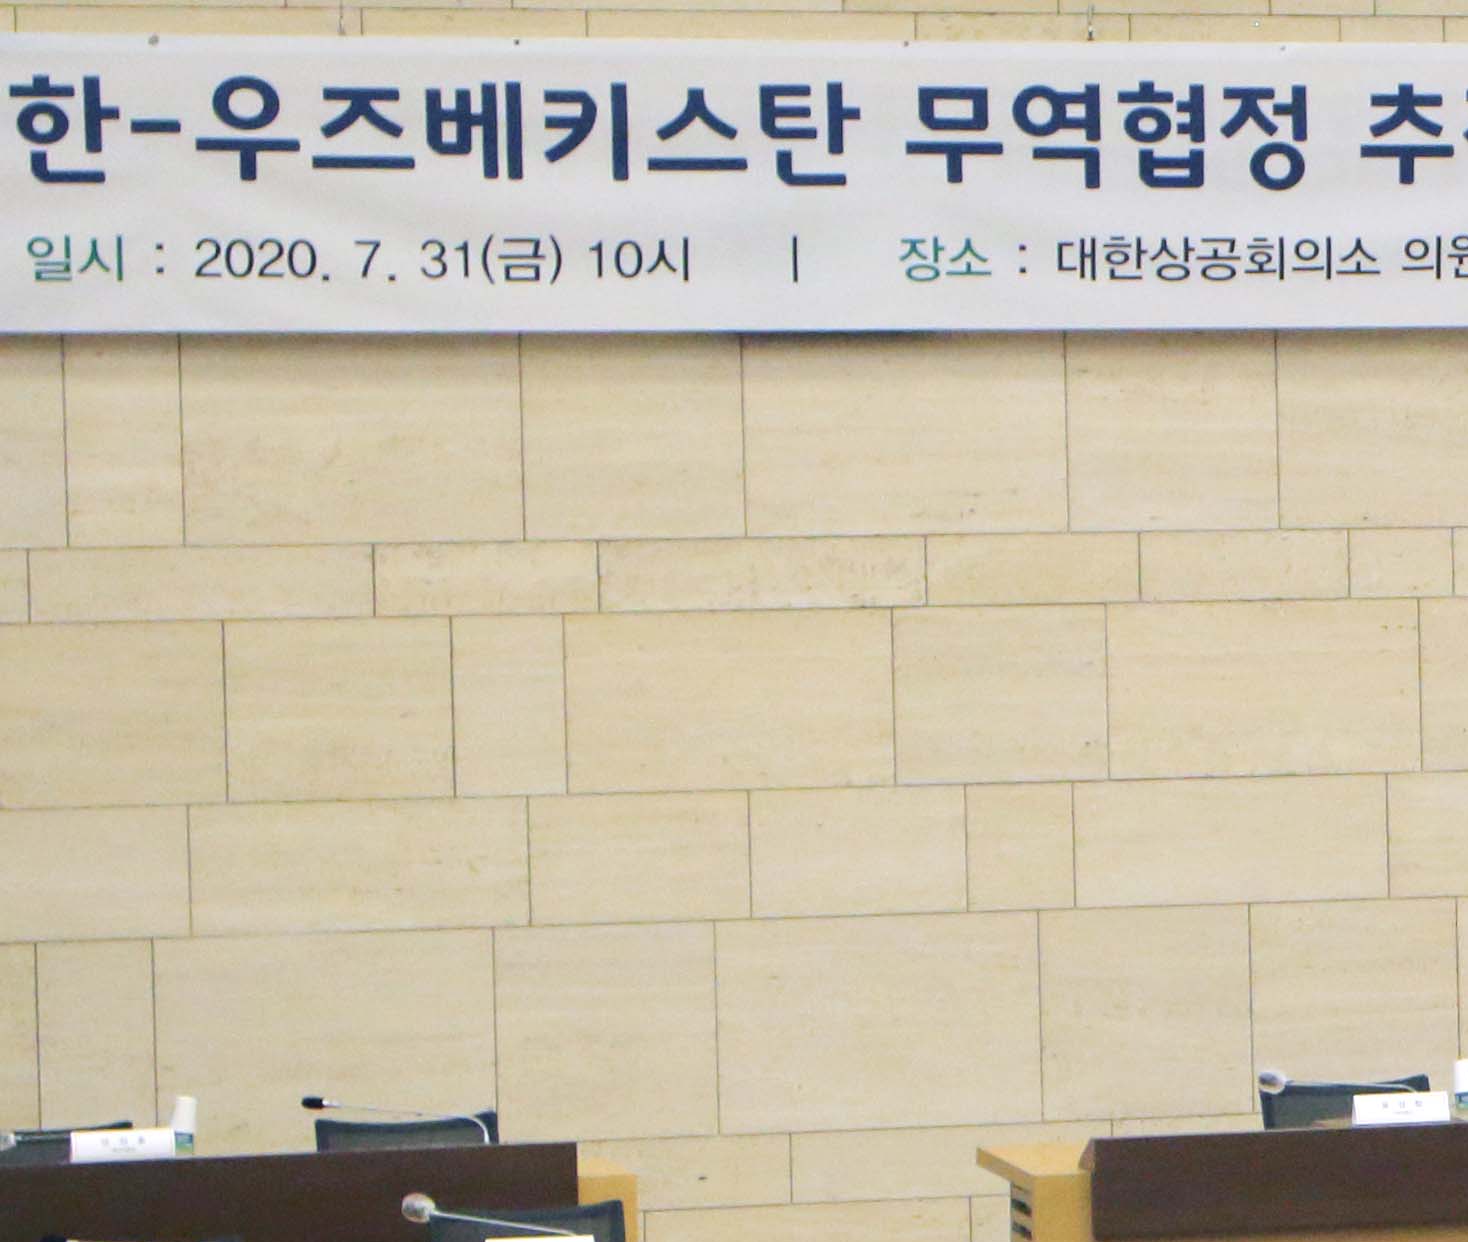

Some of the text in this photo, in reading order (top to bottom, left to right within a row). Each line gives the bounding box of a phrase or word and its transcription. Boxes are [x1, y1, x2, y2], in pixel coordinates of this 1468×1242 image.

[8, 74, 861, 187] 한-우즈베키스탄
[904, 81, 1308, 191] 무역협정
[25, 234, 125, 283] 일시
[194, 238, 331, 281] 2020.
[353, 239, 397, 281] 7.
[419, 235, 563, 284] 31(금)
[588, 235, 690, 282] 10시
[899, 235, 993, 283] 장소
[1056, 234, 1382, 283] 대한상공회의소
